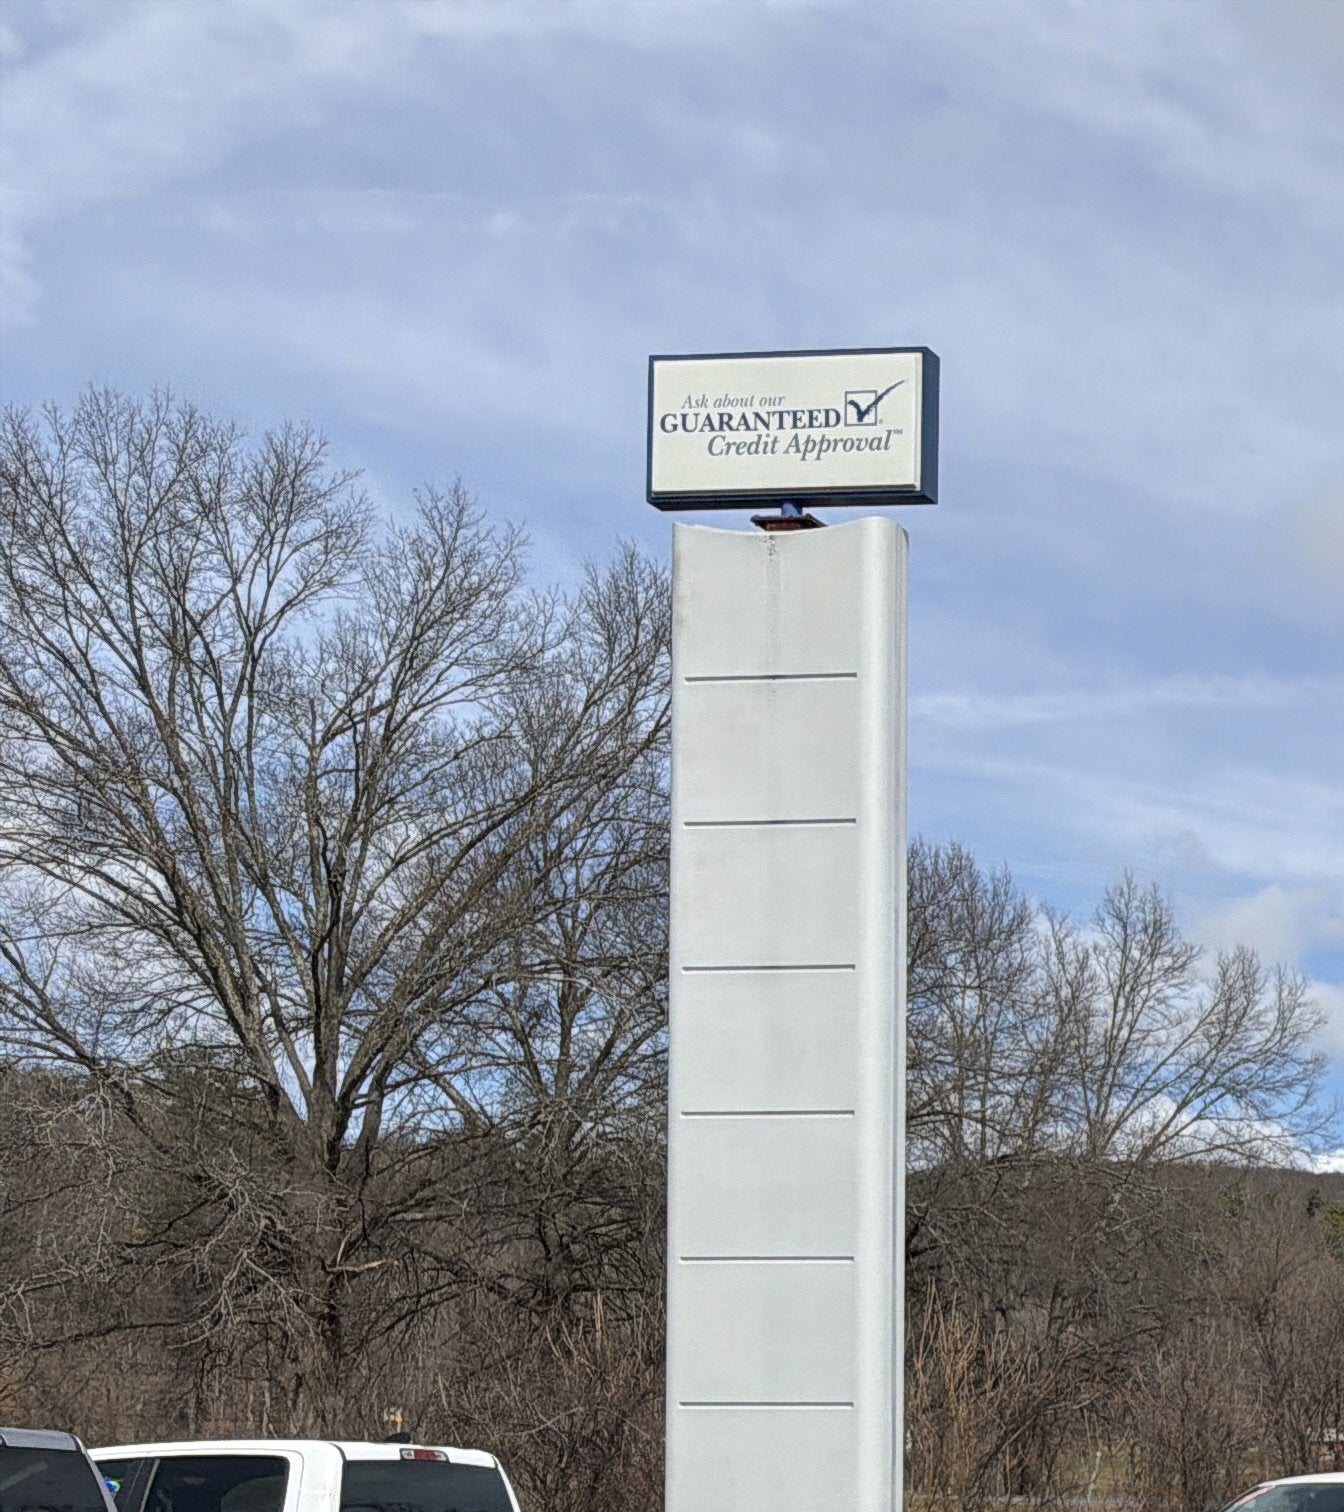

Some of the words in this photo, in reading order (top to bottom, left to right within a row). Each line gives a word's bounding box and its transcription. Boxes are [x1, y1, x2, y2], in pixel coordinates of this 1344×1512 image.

[681, 394, 708, 409] Ask
[713, 393, 754, 408] about
[759, 395, 786, 407] our
[660, 409, 841, 433] GUARANTEED
[708, 433, 780, 457] Credit
[783, 430, 892, 461] Approval
